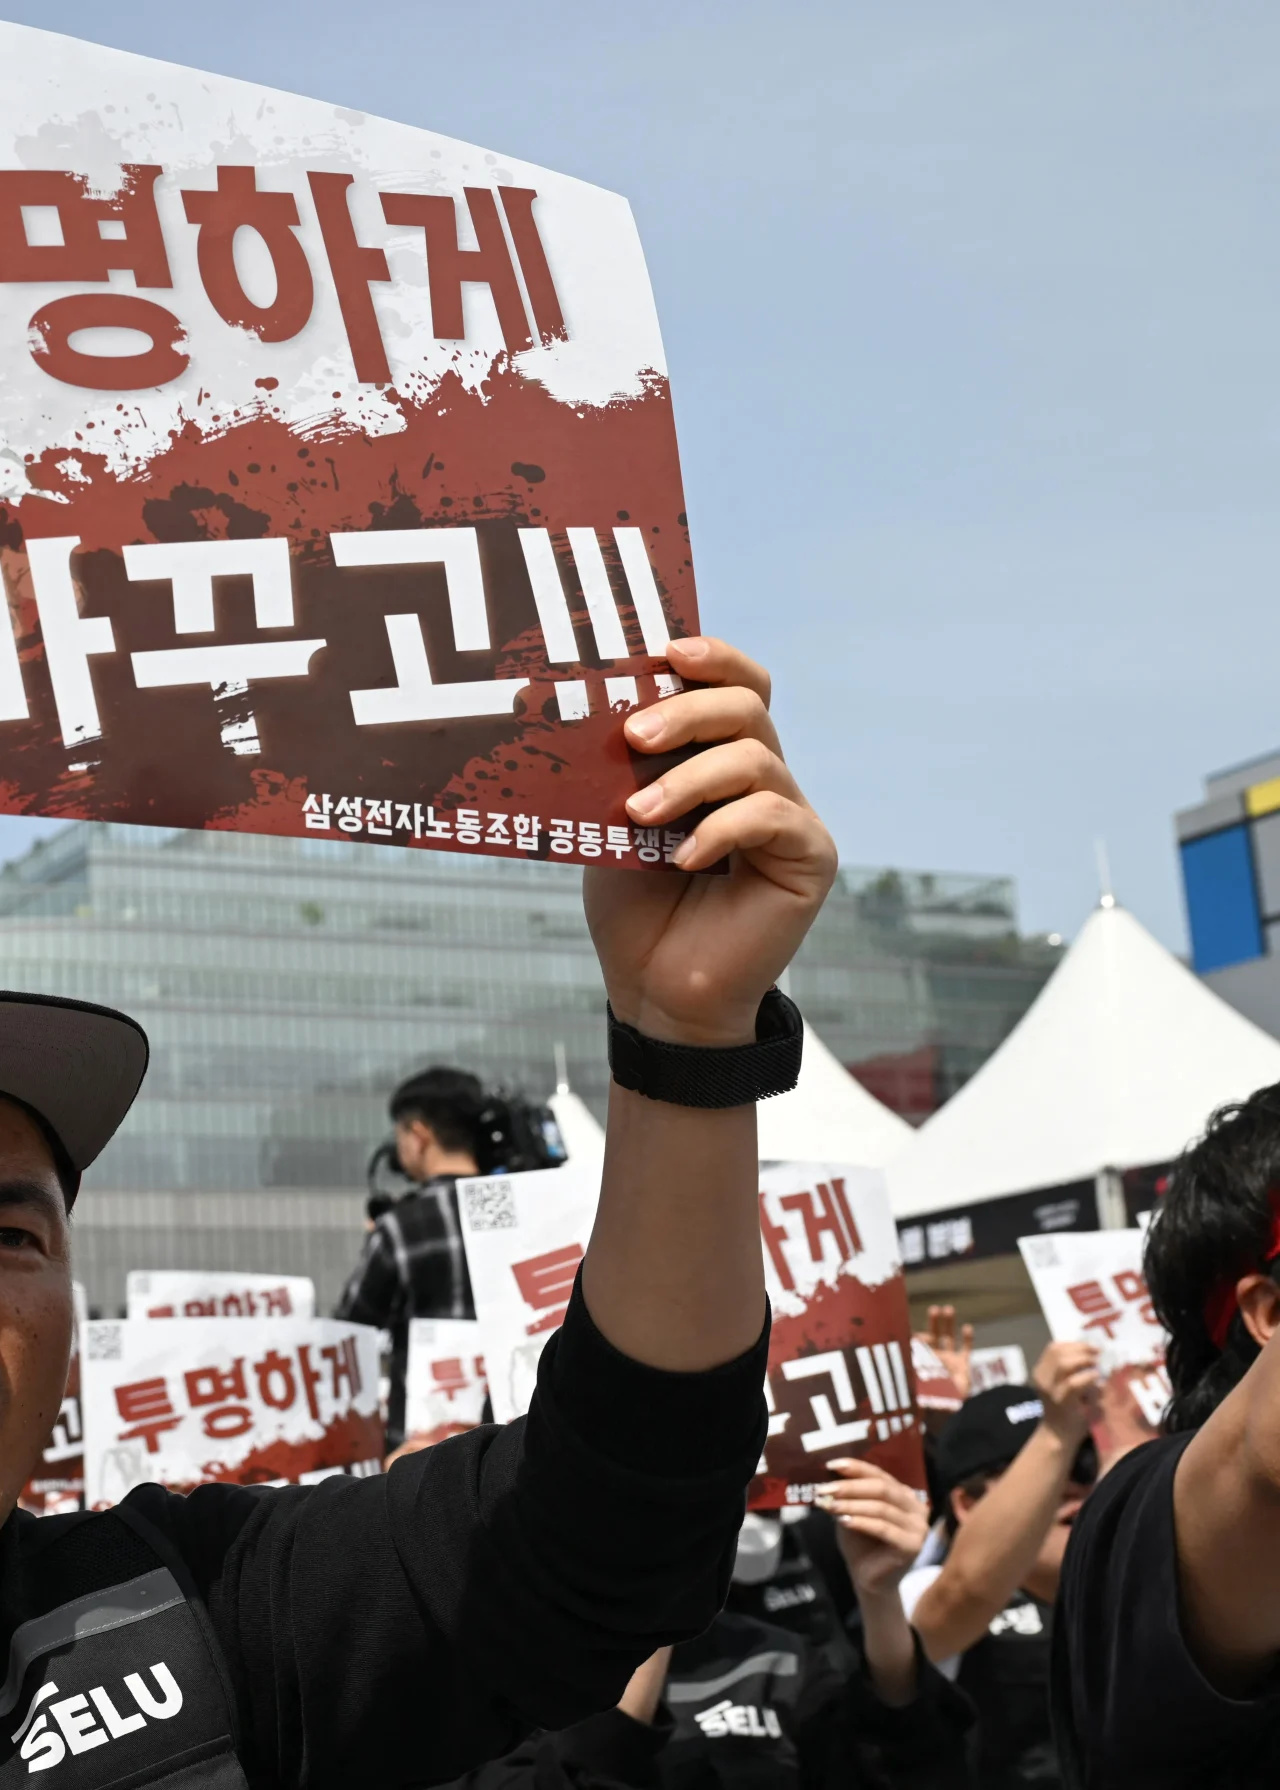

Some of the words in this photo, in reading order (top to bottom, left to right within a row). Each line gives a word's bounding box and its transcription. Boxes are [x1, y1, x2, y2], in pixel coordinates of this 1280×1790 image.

[301, 793, 541, 851] 삼성전자노동조합
[113, 1334, 363, 1453] 투명하게
[15, 1662, 183, 1773] SELU
